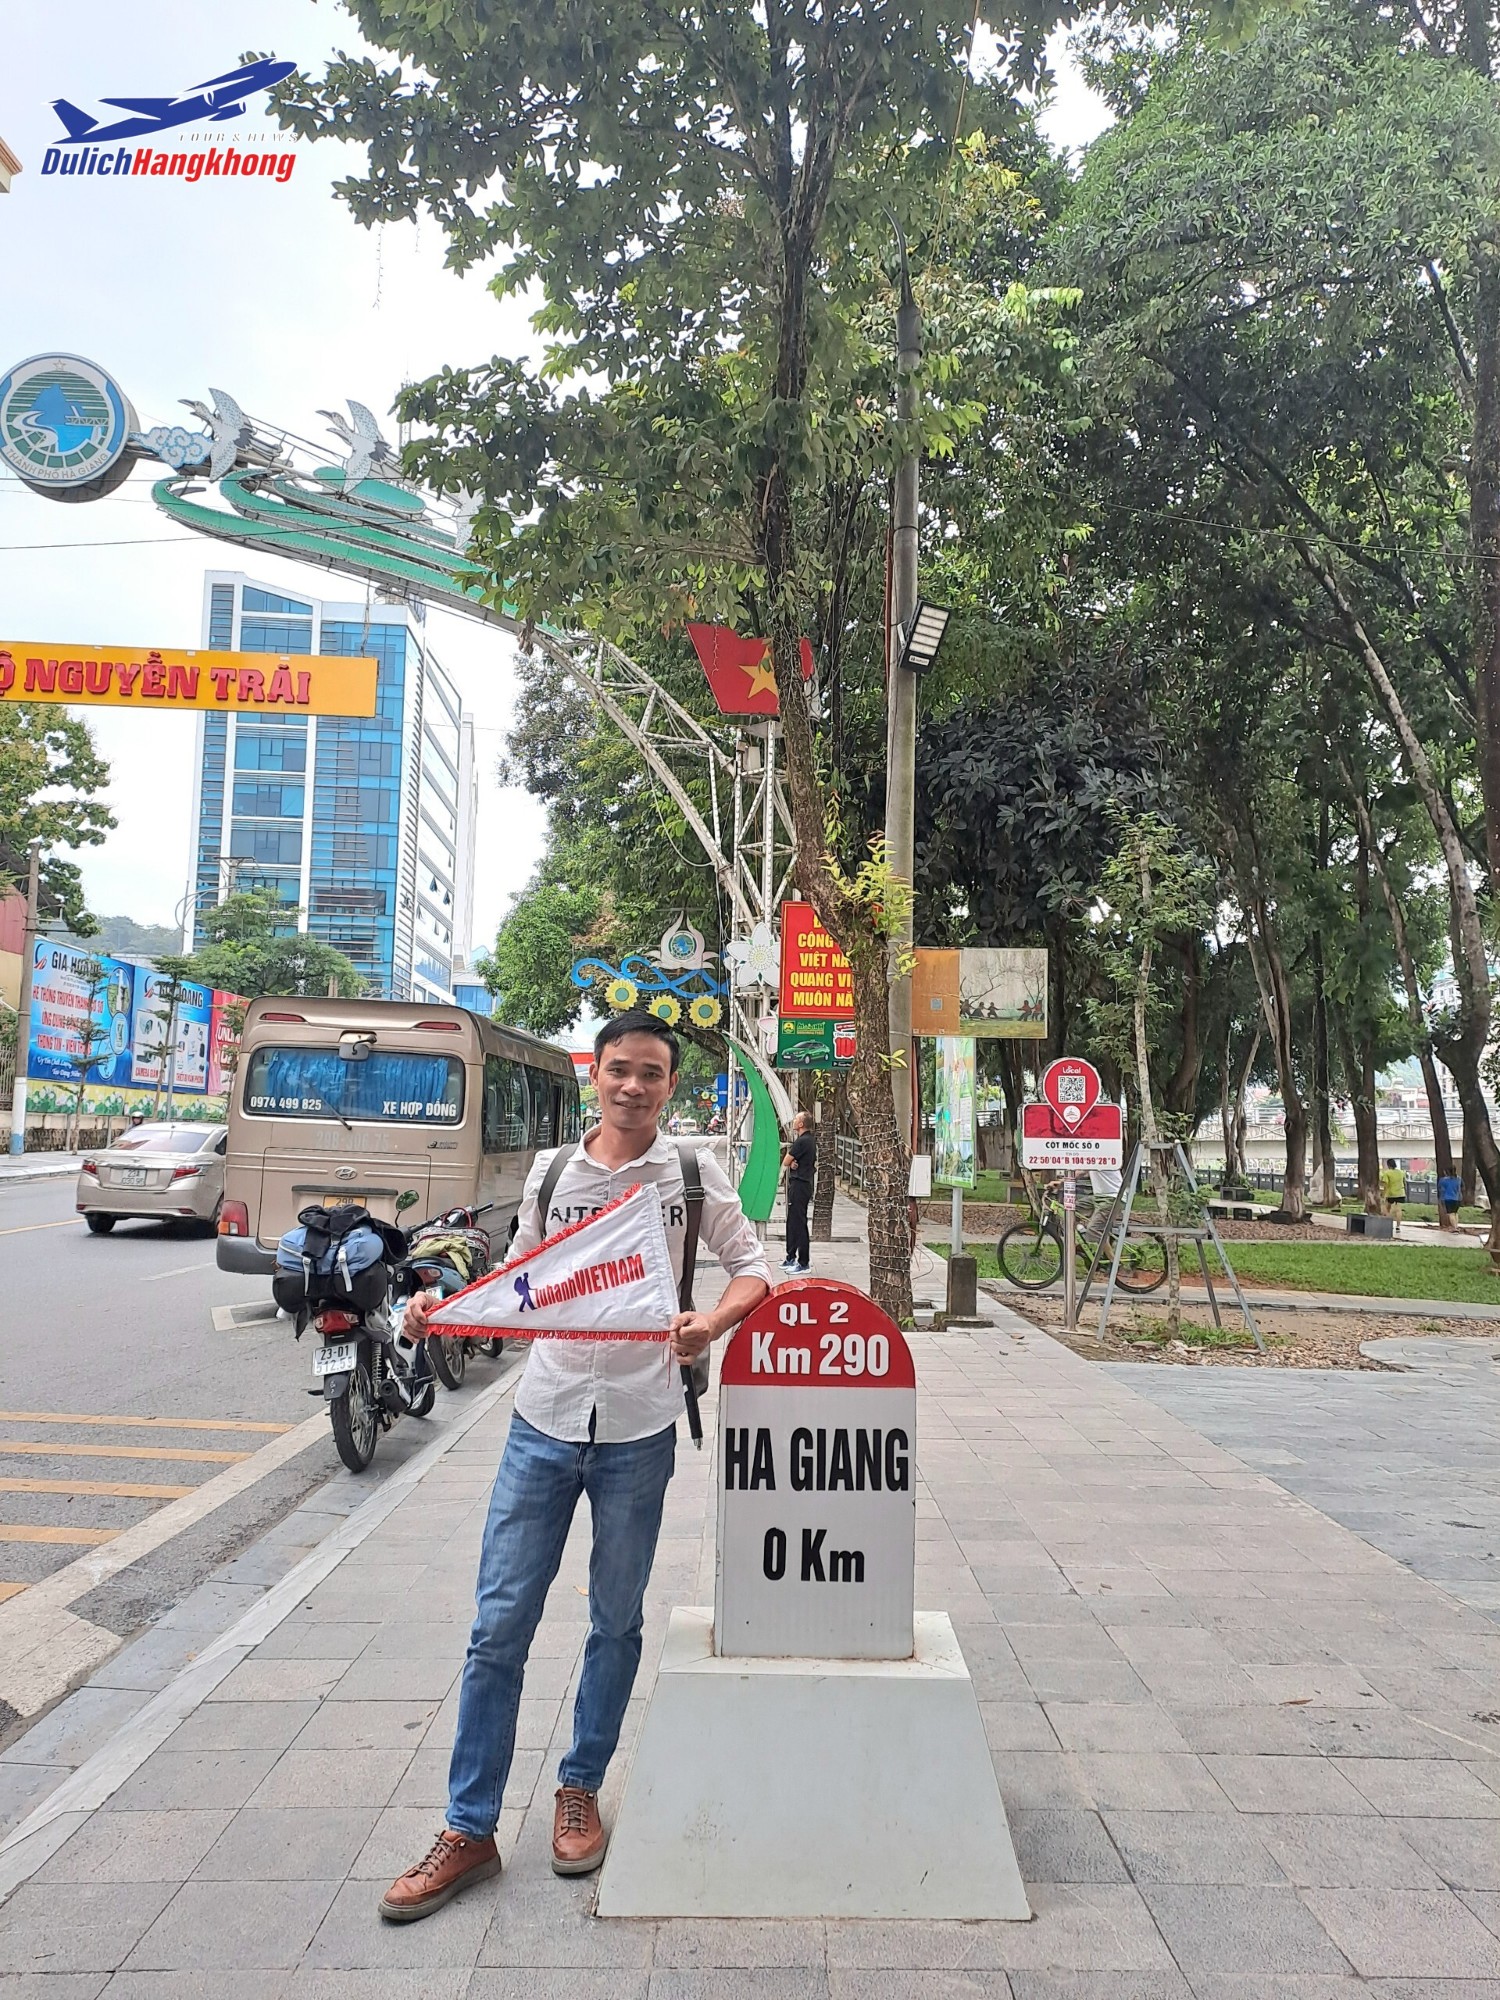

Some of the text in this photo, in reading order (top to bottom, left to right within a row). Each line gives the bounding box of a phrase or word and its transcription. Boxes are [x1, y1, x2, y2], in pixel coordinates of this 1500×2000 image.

[37, 466, 60, 480] PHỐ
[62, 467, 77, 479] HÀ
[78, 452, 109, 475] GIANG
[24, 650, 200, 699] NGUYỄN
[210, 664, 312, 705] TRÃI
[797, 931, 834, 950] CỘNG
[51, 951, 68, 972] GIA
[799, 951, 849, 970] VIỆT NA
[790, 971, 834, 988] QUANG
[793, 989, 854, 1007] MUÔN NĂ
[250, 1096, 322, 1111] 0974 499 825
[382, 1097, 457, 1119] XE HỢP ĐỒNG
[1094, 1142, 1100, 1150] 0
[778, 1301, 849, 1325] QL 2
[751, 1331, 889, 1377] Km 290
[725, 1426, 909, 1492] HA GIANG
[762, 1526, 865, 1583] 0 Km
